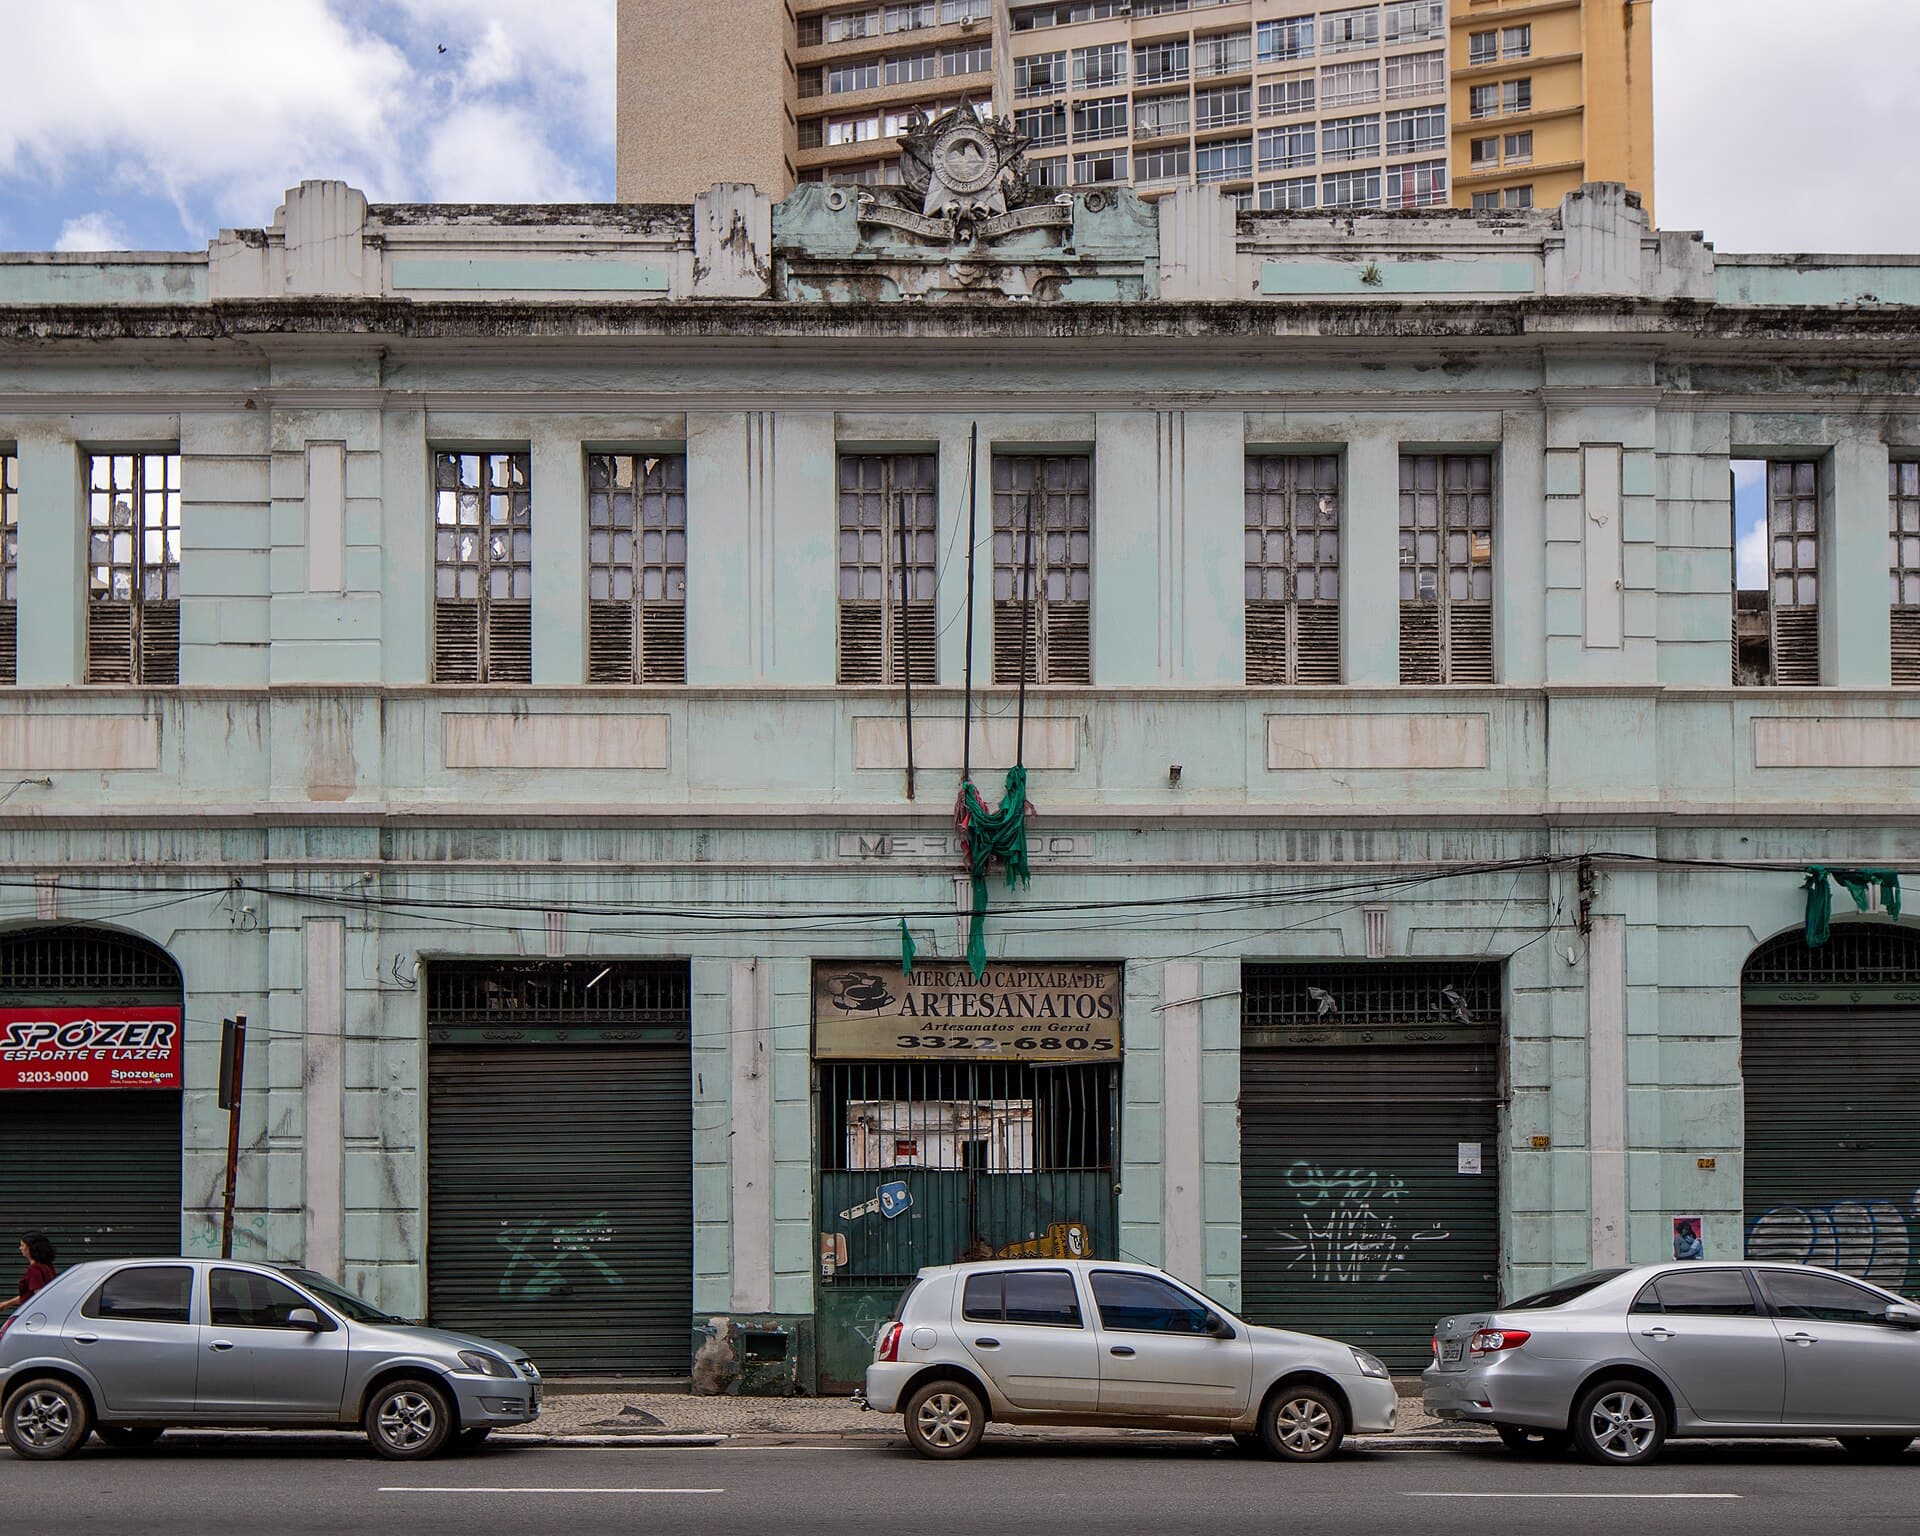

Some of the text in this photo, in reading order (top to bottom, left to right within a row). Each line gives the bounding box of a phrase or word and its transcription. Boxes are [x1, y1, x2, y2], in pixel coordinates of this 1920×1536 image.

[859, 836, 1075, 854] MERDO
[908, 971, 1105, 988] MERCADO CAPIXABA DE
[897, 992, 1114, 1019] ARTESANATOS
[920, 1022, 1091, 1032] Artesanatos em Geral
[896, 1035, 1114, 1051] 3322-6805
[3, 1050, 170, 1061] ESPORTE E LAZER
[18, 1071, 89, 1082] 3203-9000
